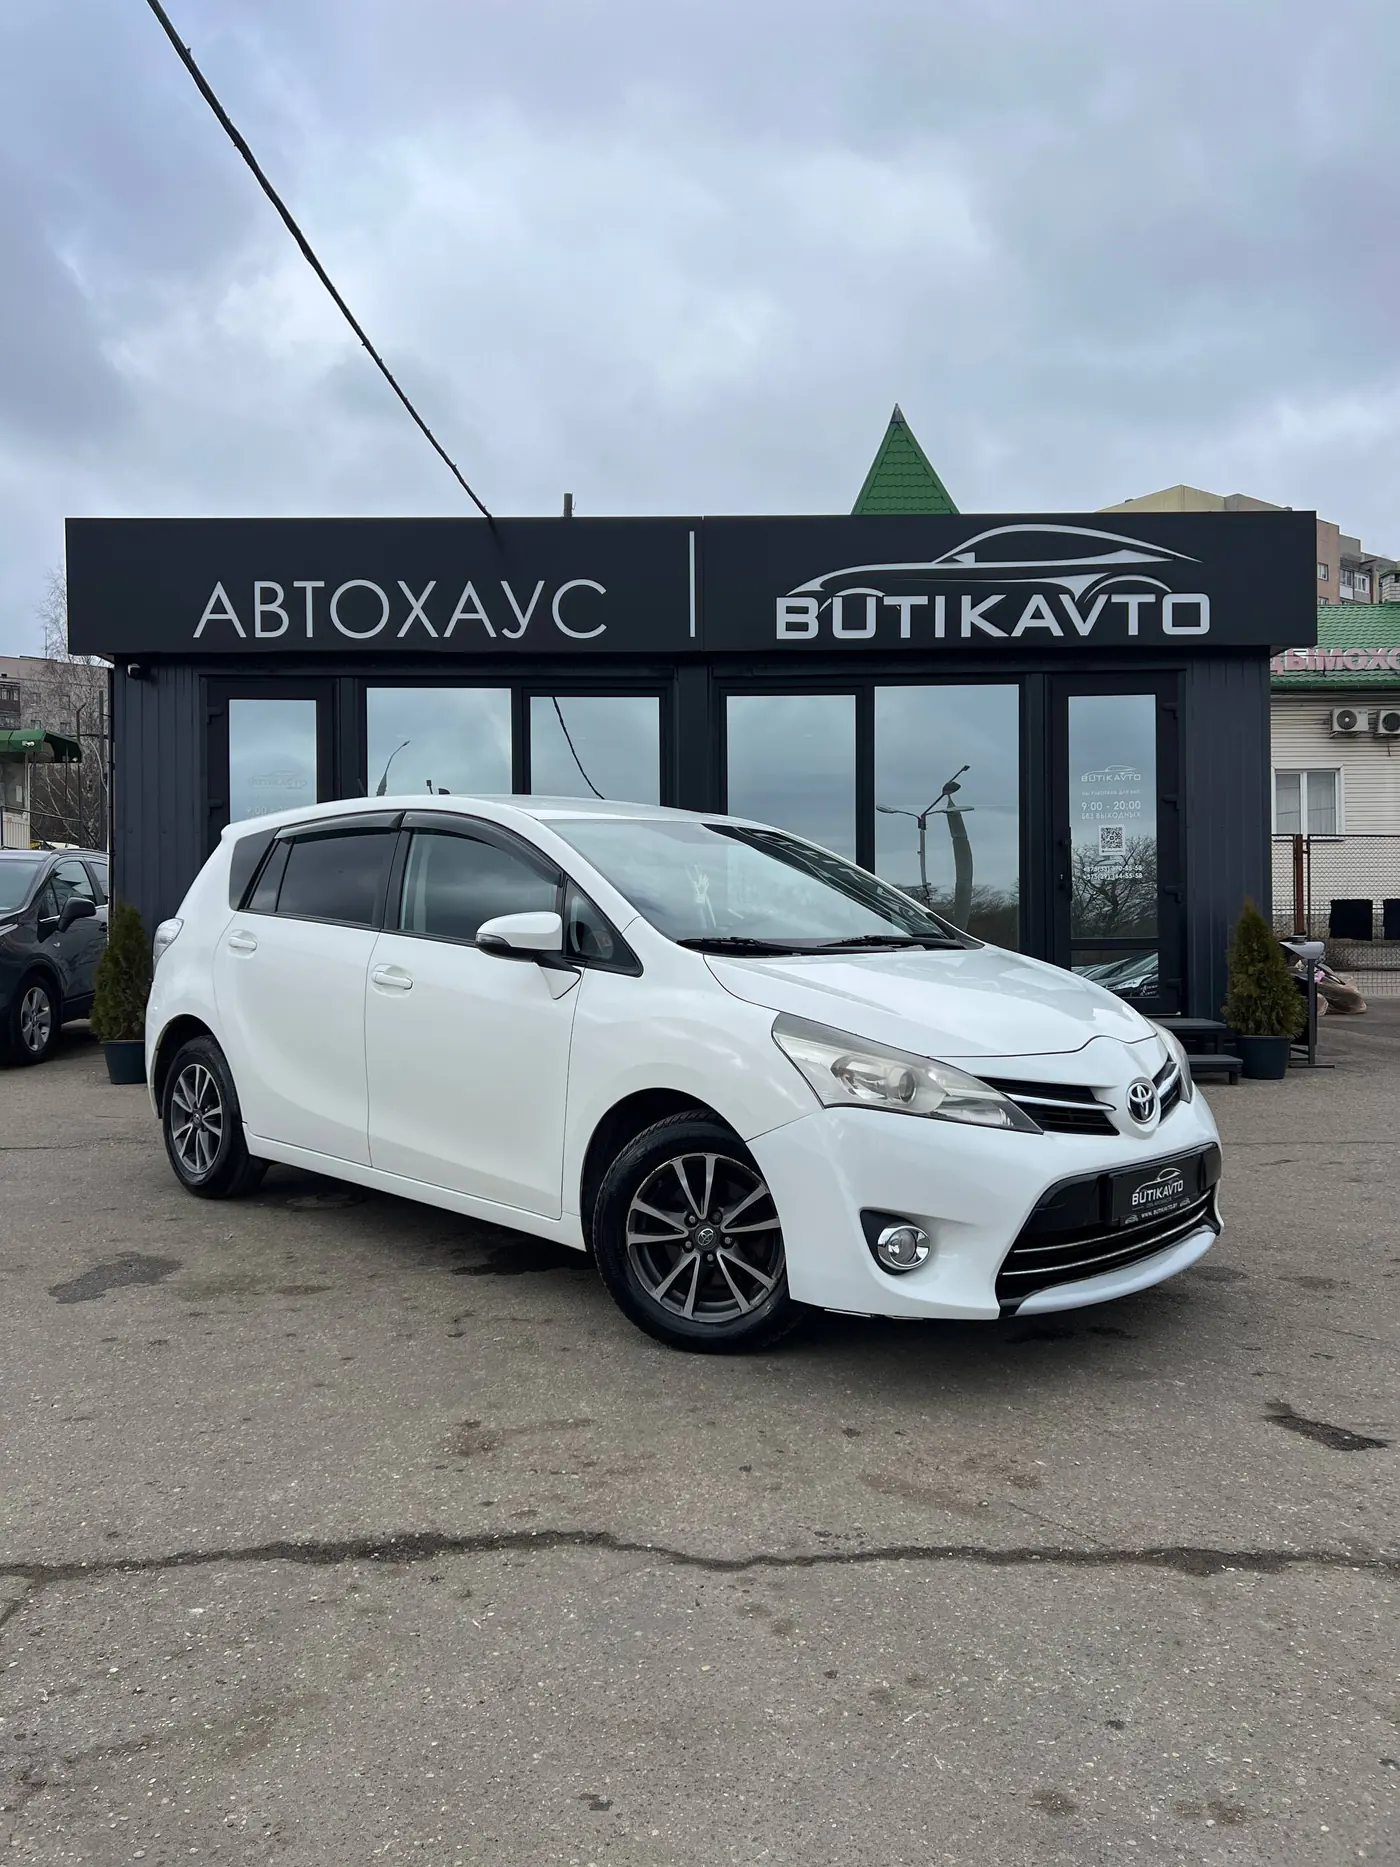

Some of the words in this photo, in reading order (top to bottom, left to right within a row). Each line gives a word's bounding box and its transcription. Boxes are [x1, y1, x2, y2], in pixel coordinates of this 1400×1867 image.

[193, 579, 607, 638] АВТОХАУС
[776, 593, 1210, 639] BUTIKAVTO
[1081, 774, 1141, 782] BUTIKAVTO
[1081, 802, 1103, 811] 9:00
[1113, 801, 1141, 810] 20:00
[1131, 1180, 1184, 1206] BUTIKAVTO
